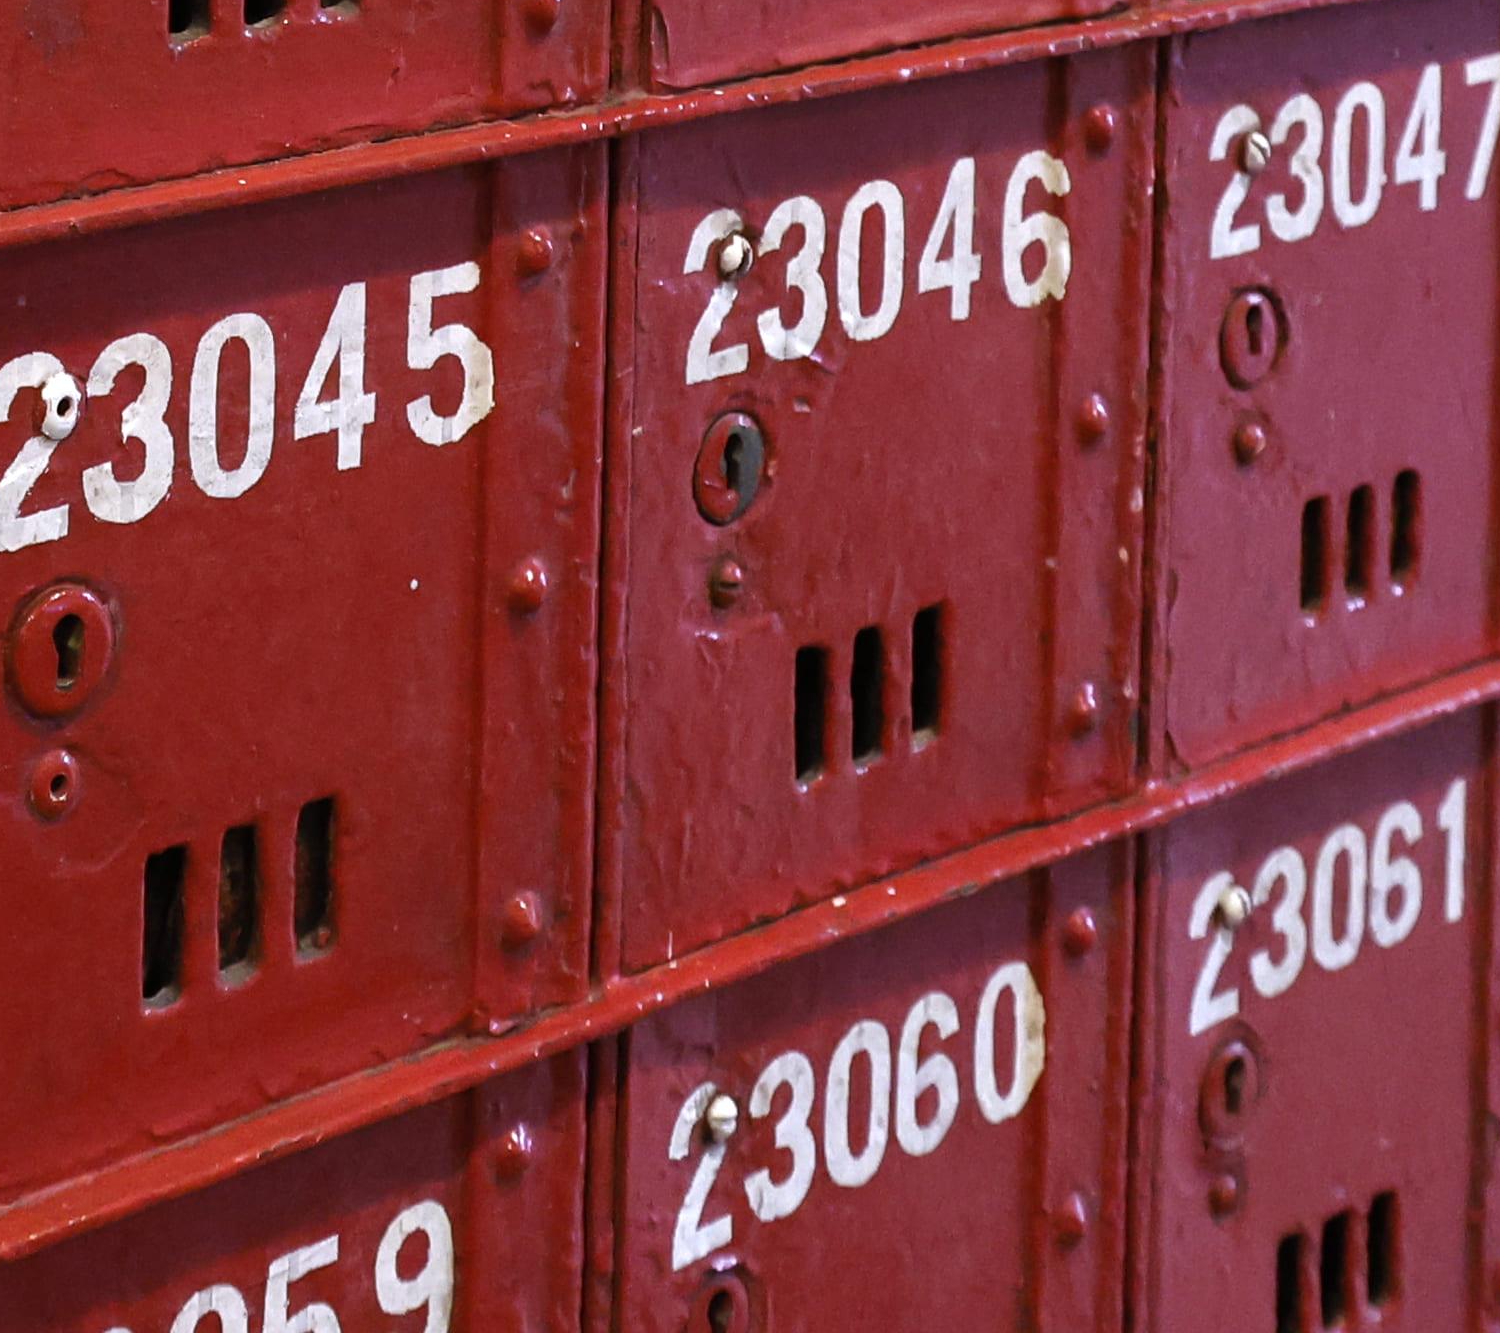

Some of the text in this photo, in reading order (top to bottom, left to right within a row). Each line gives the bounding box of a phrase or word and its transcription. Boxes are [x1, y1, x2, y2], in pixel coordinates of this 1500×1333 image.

[684, 150, 1071, 384] 23046
[1189, 780, 1465, 1036] 23061
[669, 962, 1044, 1271] 23060
